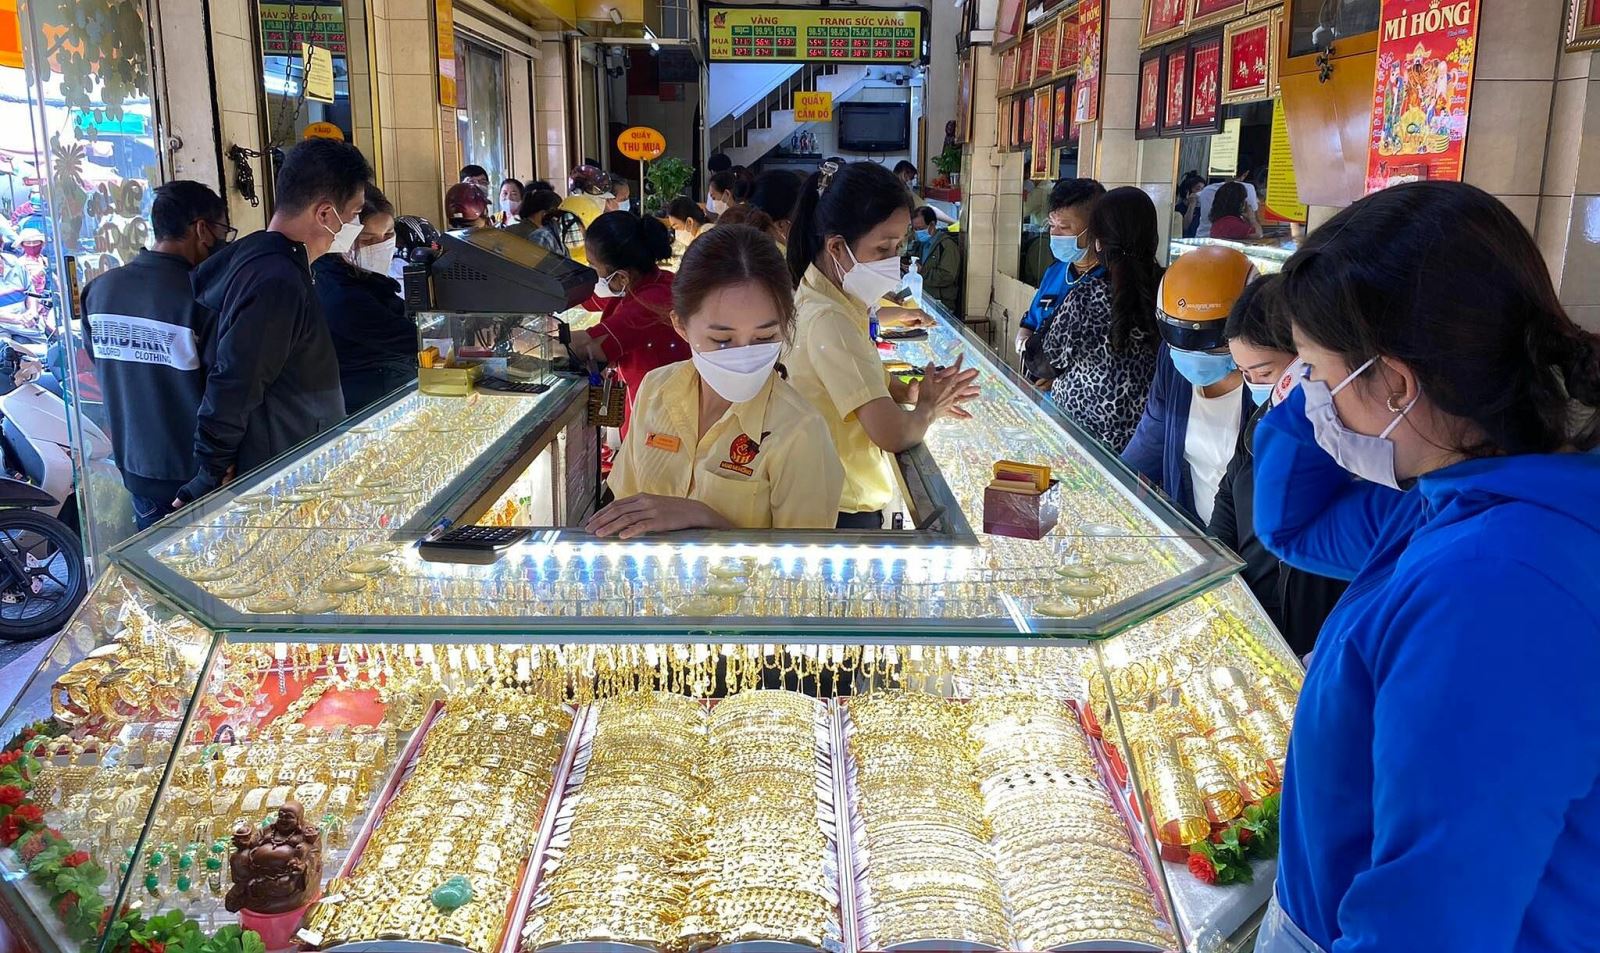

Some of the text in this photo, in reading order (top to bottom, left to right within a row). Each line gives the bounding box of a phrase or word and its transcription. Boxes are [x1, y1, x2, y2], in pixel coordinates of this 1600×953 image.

[751, 14, 778, 25] VÀNG
[819, 15, 905, 26] TRANG SỨC VÀNG
[623, 143, 660, 152] THU MUA
[135, 350, 173, 364] CLOTHING
